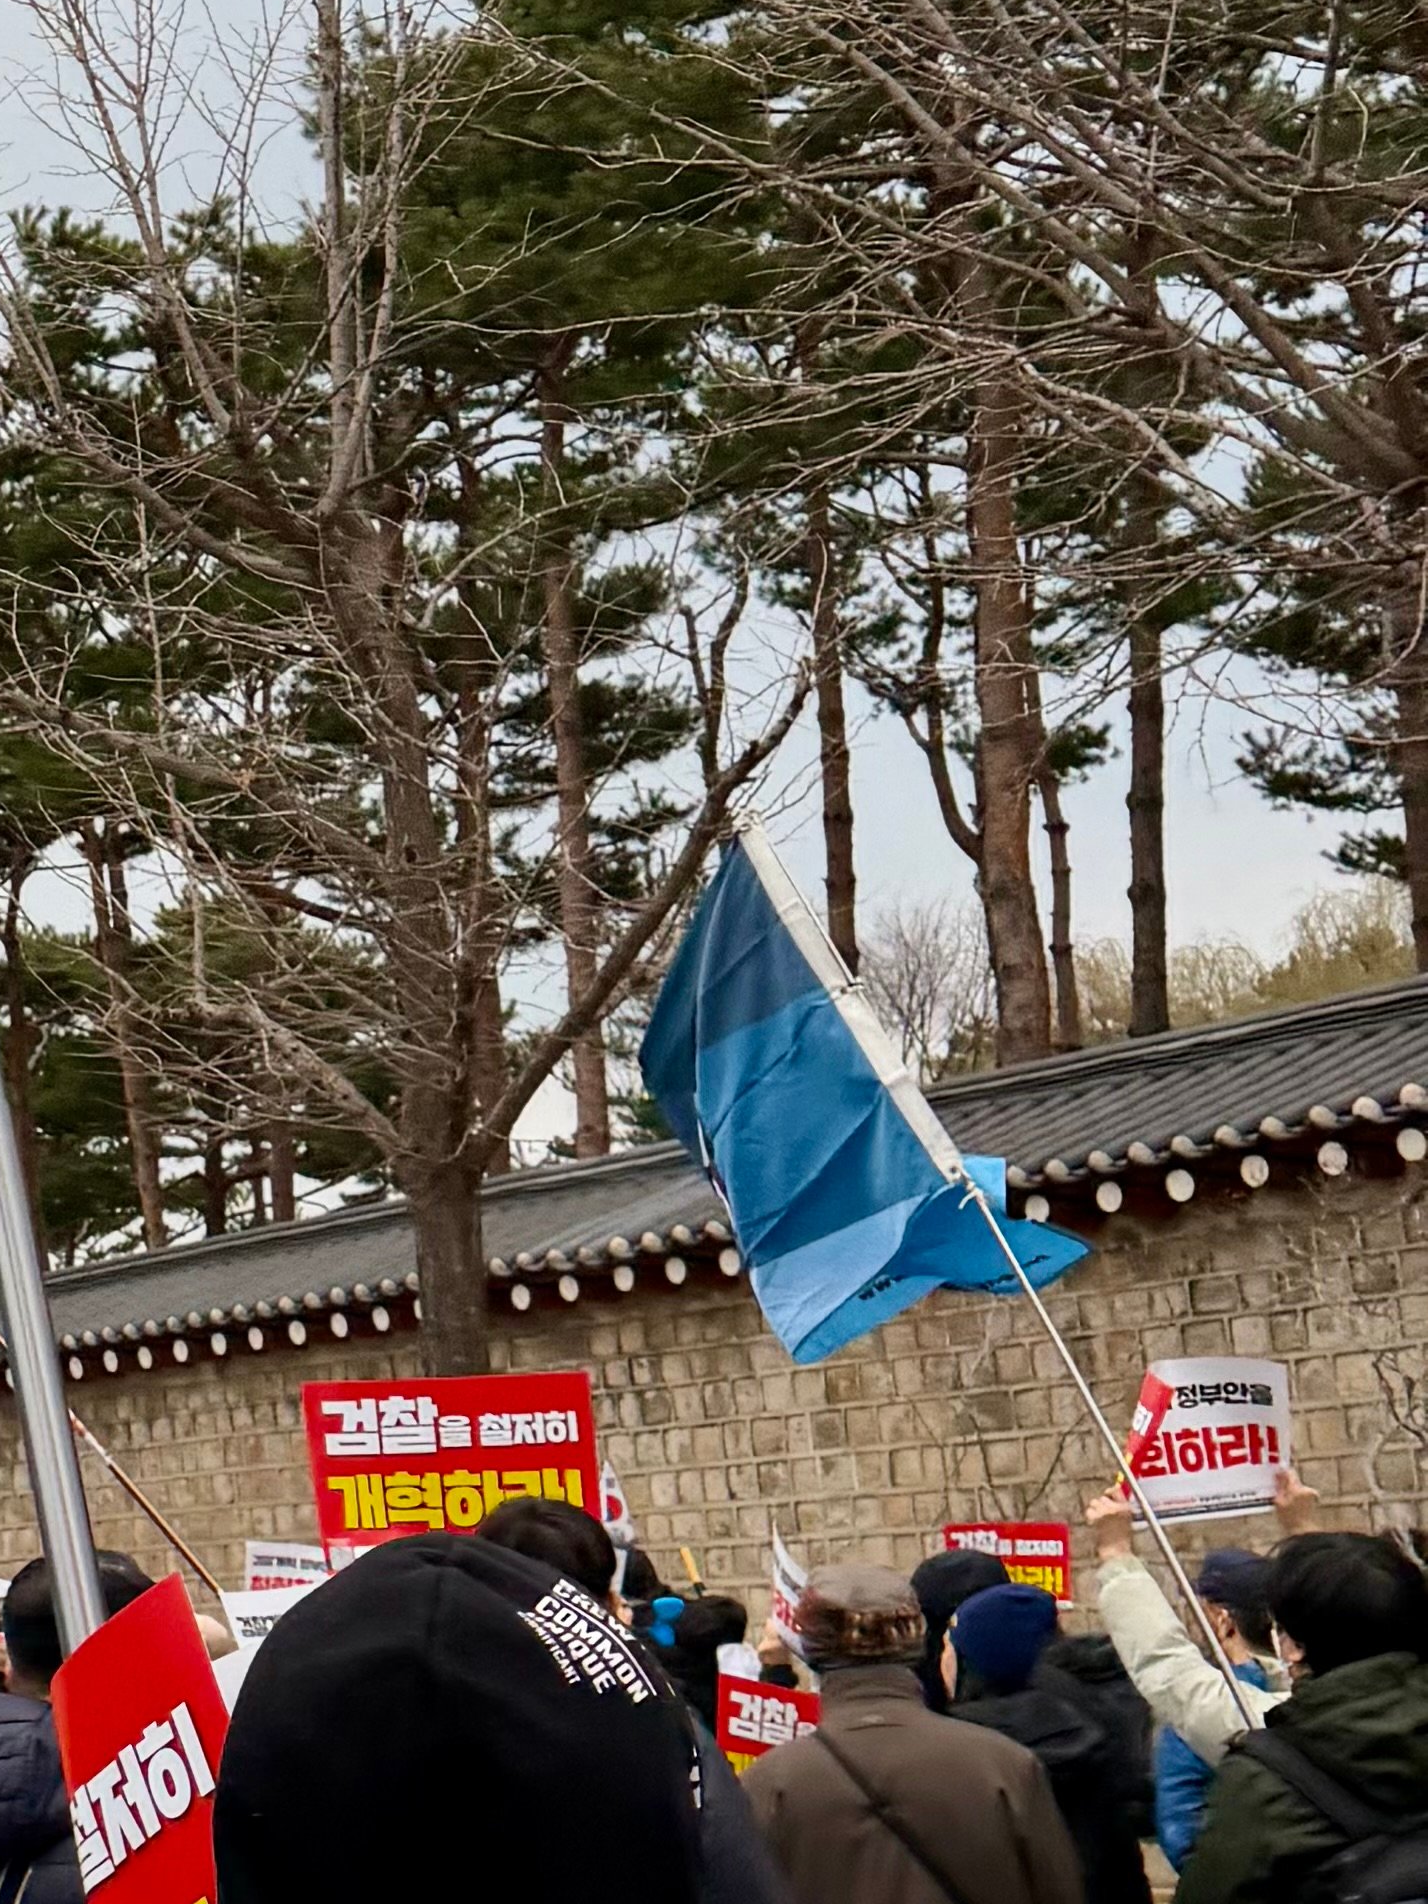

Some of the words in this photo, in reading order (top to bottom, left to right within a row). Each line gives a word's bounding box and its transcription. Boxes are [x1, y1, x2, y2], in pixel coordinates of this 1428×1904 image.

[321, 1396, 472, 1456] 검찰을
[478, 1410, 579, 1447] 철저히
[1175, 1382, 1273, 1409] 정부안을
[534, 1595, 650, 1705] COMMON
[70, 1702, 216, 1895] 철저히
